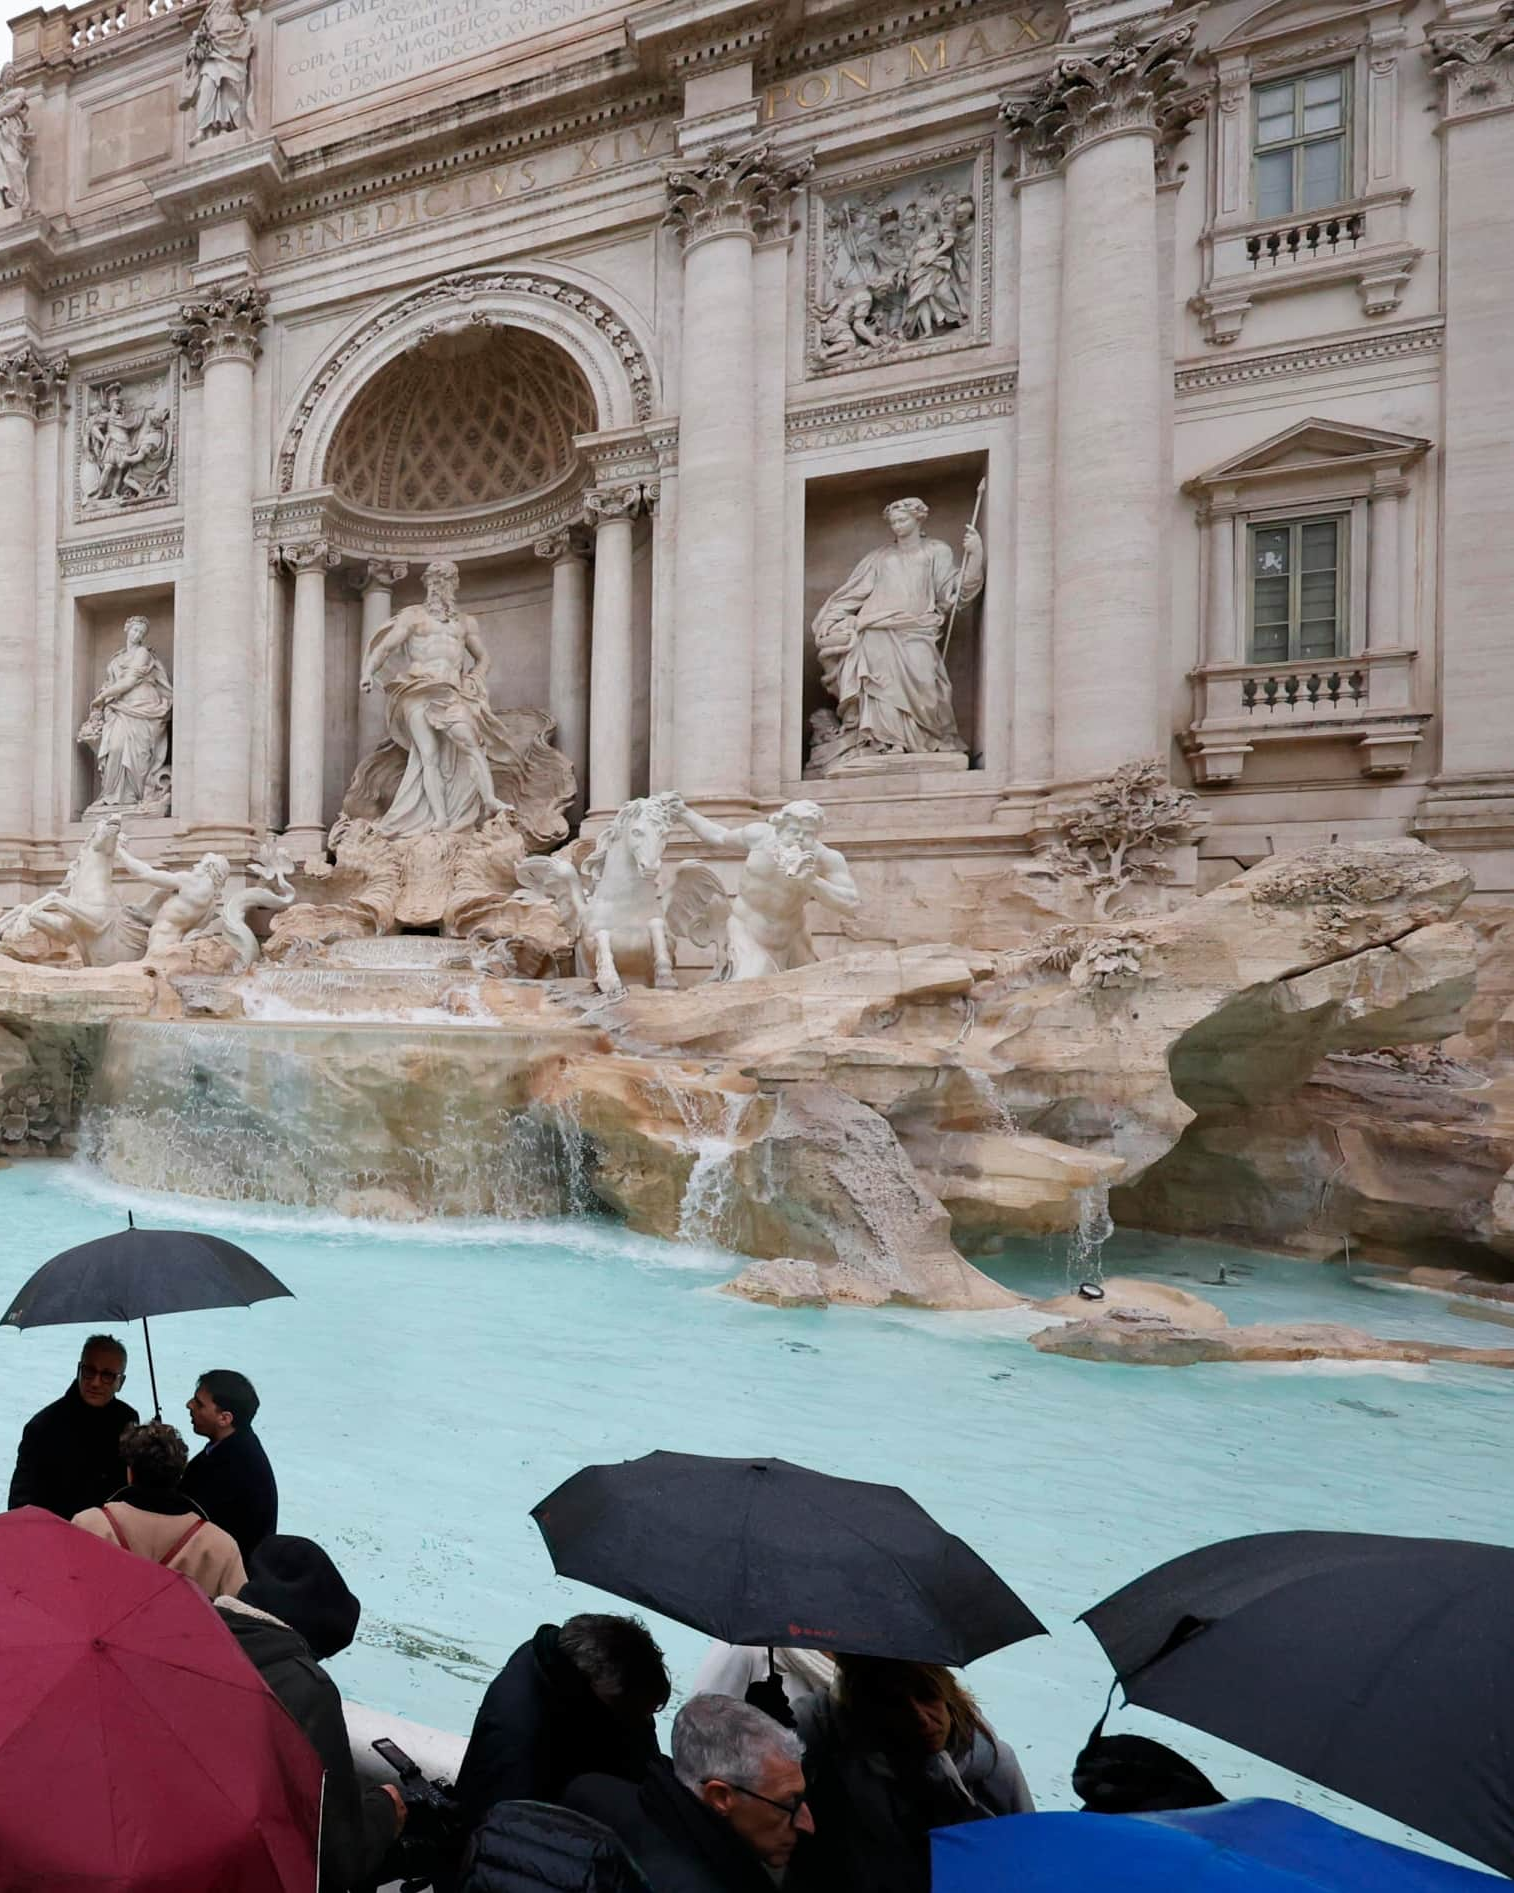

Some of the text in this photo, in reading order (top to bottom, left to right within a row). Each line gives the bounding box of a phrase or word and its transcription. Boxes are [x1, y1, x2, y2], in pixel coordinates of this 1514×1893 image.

[395, 9, 501, 57] MAGNIFICO
[287, 52, 335, 76] COPIA
[344, 40, 364, 57] ET
[294, 84, 343, 110] ANNO
[349, 59, 413, 92] DOMINI
[275, 160, 537, 259] BENEDICTVS
